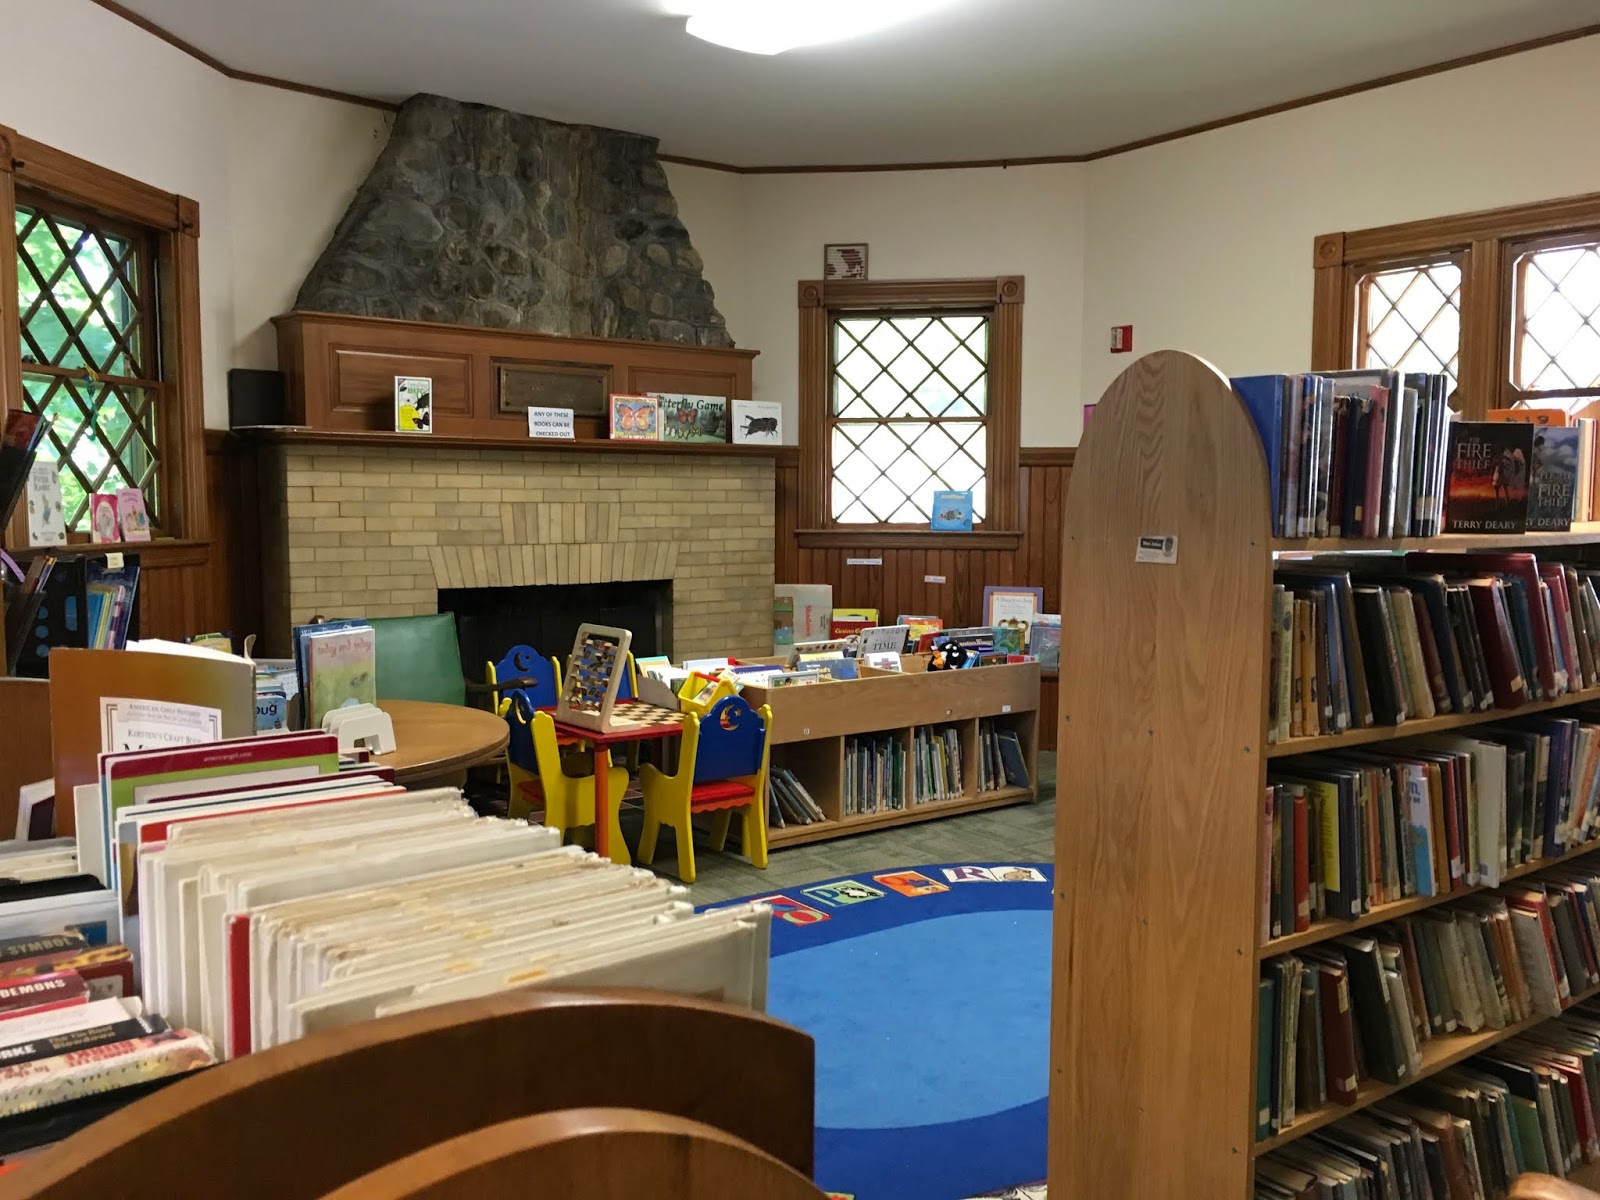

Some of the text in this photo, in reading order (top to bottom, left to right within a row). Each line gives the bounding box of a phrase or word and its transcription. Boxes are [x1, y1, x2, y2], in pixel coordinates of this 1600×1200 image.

[658, 398, 694, 410] tterfly
[697, 399, 724, 411] Game
[1457, 442, 1492, 459] FIRE
[1457, 458, 1492, 470] THIEF
[1538, 483, 1570, 498] FIRE
[1538, 497, 1569, 507] THIEF
[1452, 520, 1483, 529] TERRY
[1484, 520, 1518, 530] DEARY
[1537, 517, 1569, 527] DEARY
[318, 638, 372, 658] today and today
[872, 641, 897, 651] TIME
[163, 732, 184, 743] CRAFT
[951, 867, 990, 880] R
[7, 937, 74, 956] SYMBOL
[0, 979, 66, 999] DEMONS
[0, 1043, 37, 1060] RKE
